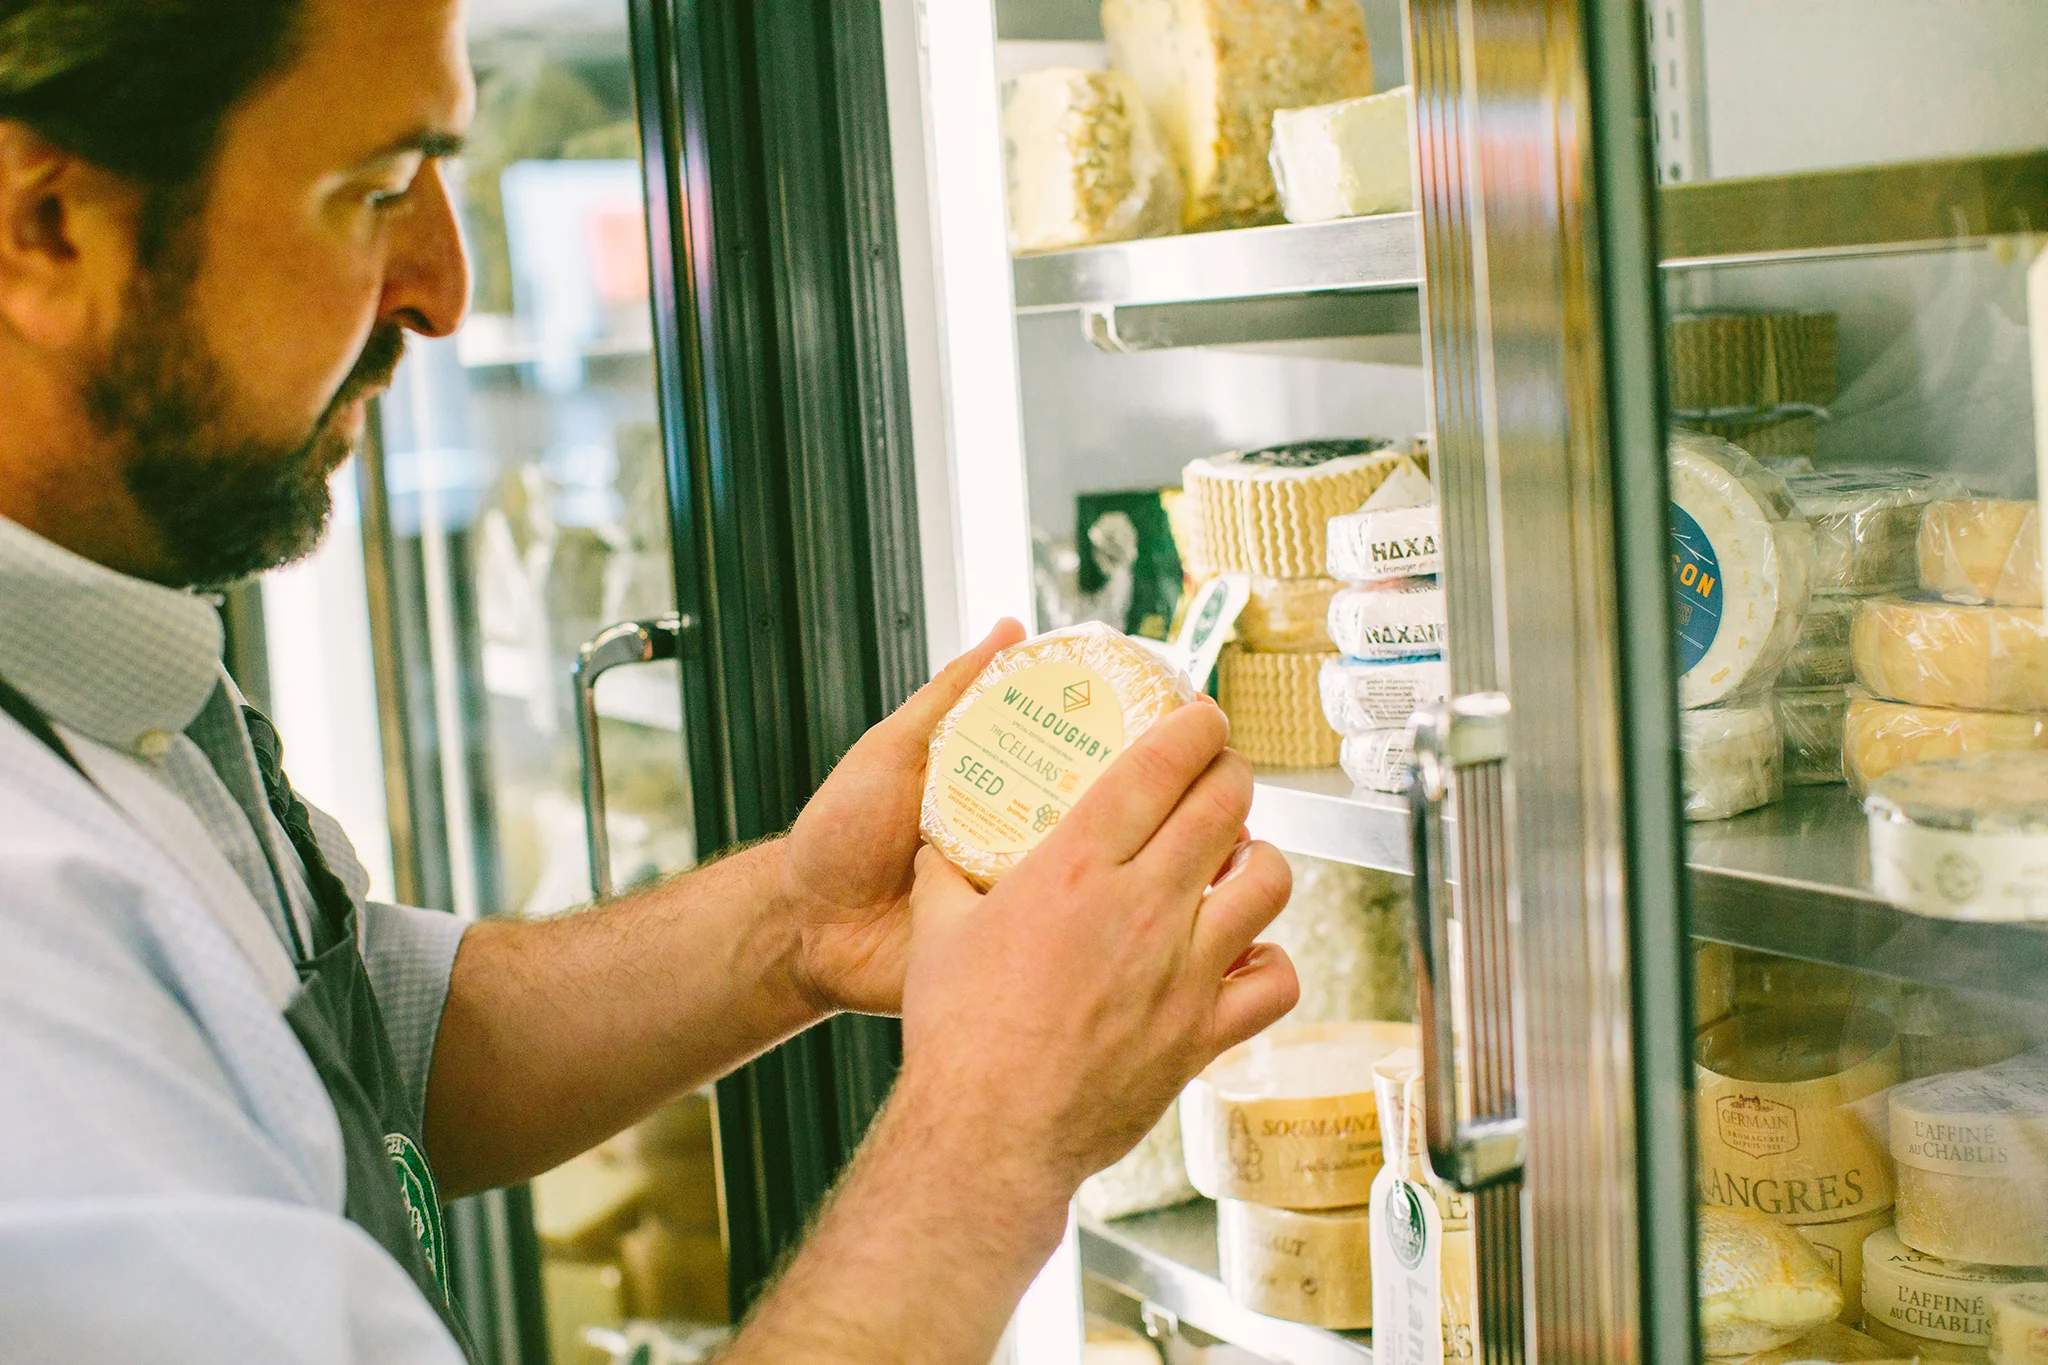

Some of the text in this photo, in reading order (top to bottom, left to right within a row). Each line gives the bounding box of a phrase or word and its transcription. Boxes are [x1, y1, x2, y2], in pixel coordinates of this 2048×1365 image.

[1371, 534, 1441, 562] HAXA
[1003, 686, 1112, 763] WILLOUGHBY
[990, 724, 1062, 781] THE CELLARS
[954, 755, 1004, 796] SEED
[1722, 1109, 1789, 1130] GERMAIN
[1908, 1142, 2008, 1163] AU CHABLIS
[1702, 1168, 1864, 1215] ANGRES
[1898, 1285, 1984, 1316] L'AFFINÉ
[1405, 1276, 1428, 1365] Lan
[1889, 1307, 1992, 1335] AU CHABLIS
